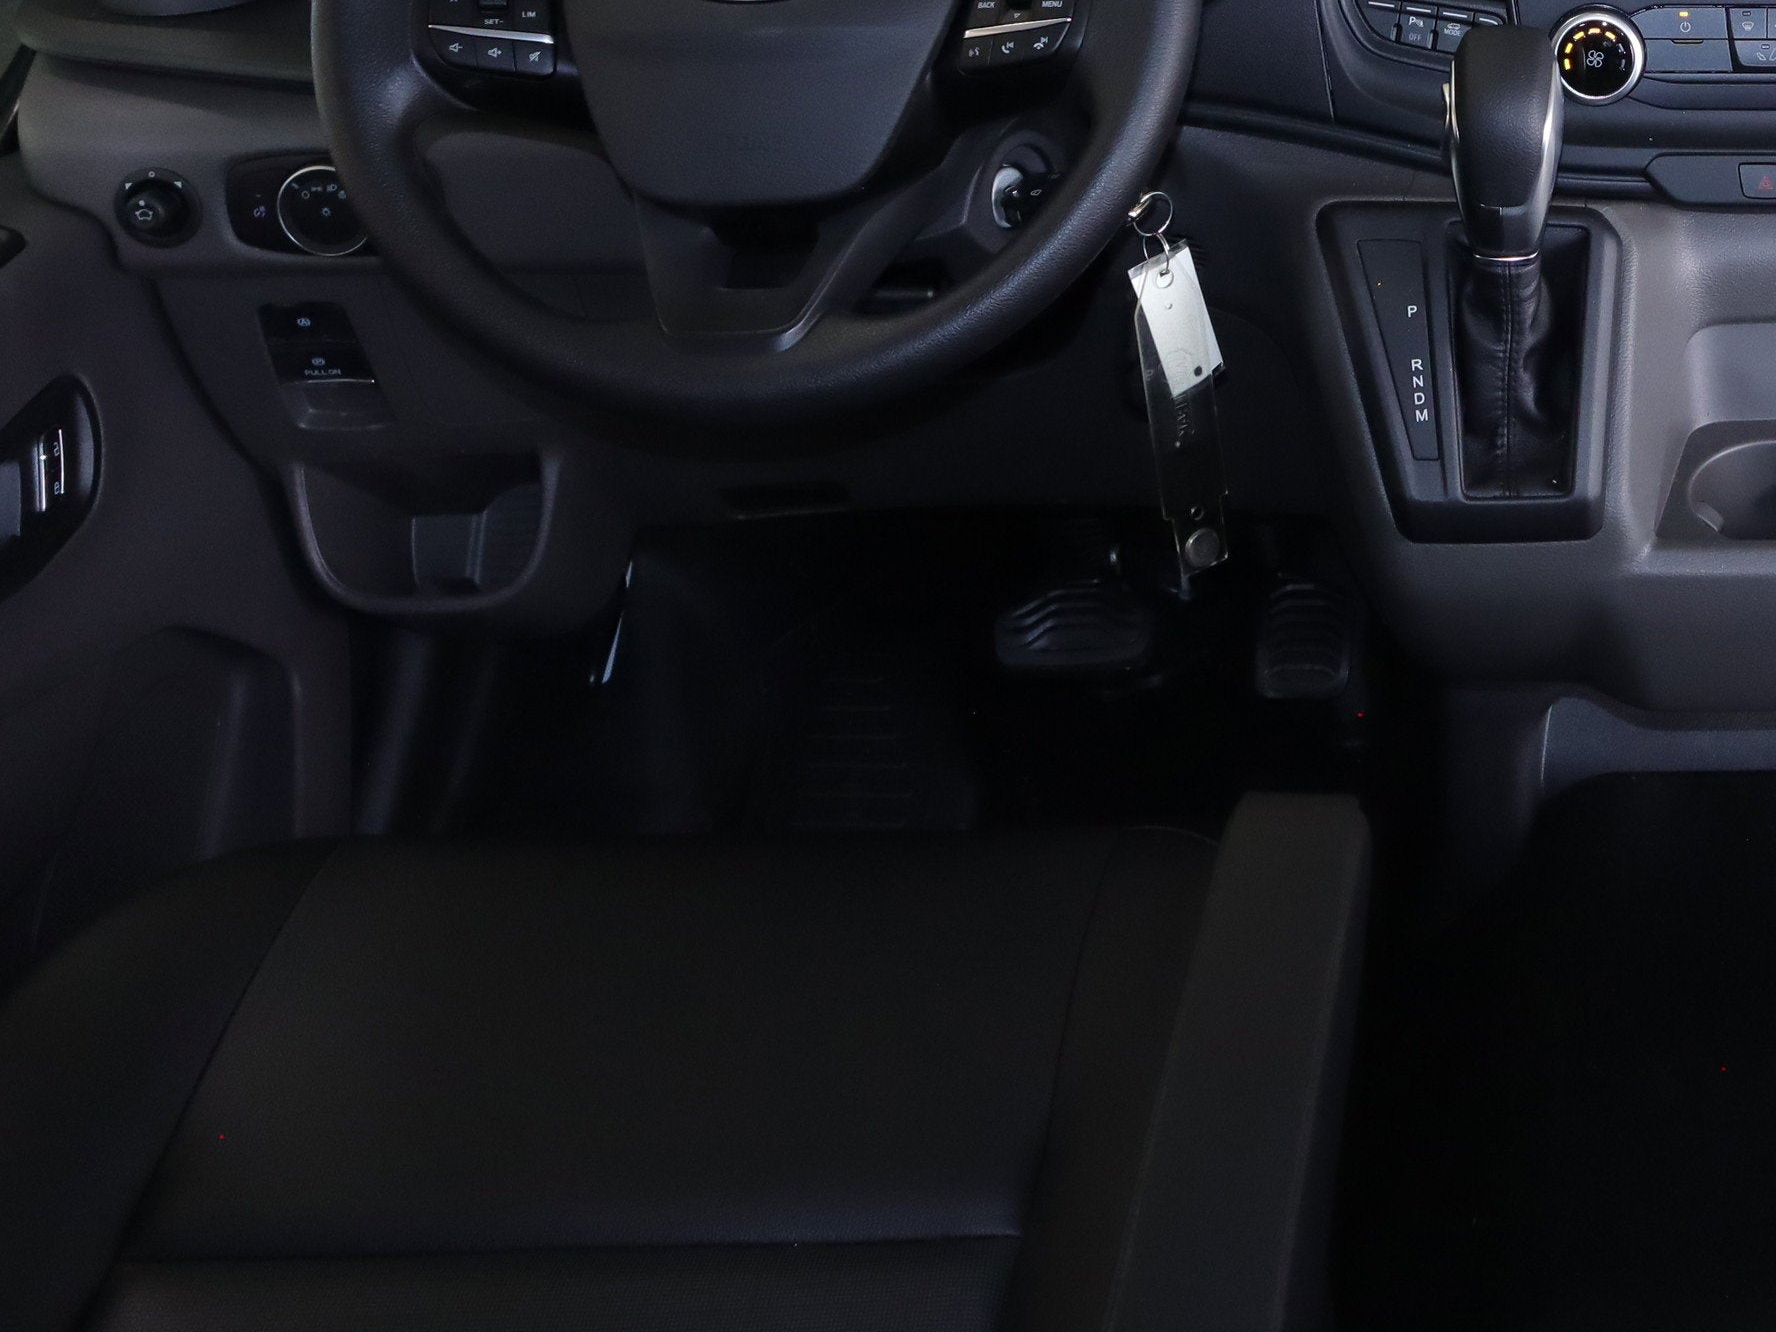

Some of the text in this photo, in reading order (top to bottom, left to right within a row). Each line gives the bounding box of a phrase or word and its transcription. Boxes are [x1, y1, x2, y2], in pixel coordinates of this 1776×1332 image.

[977, 1, 996, 9] BACK
[1041, 0, 1063, 8] MENU
[1409, 33, 1421, 41] OFF
[1444, 28, 1462, 37] MODE
[1407, 305, 1418, 318] P
[1411, 358, 1424, 372] R
[1412, 374, 1424, 388] N
[1414, 392, 1425, 405] D
[1415, 408, 1429, 423] M
